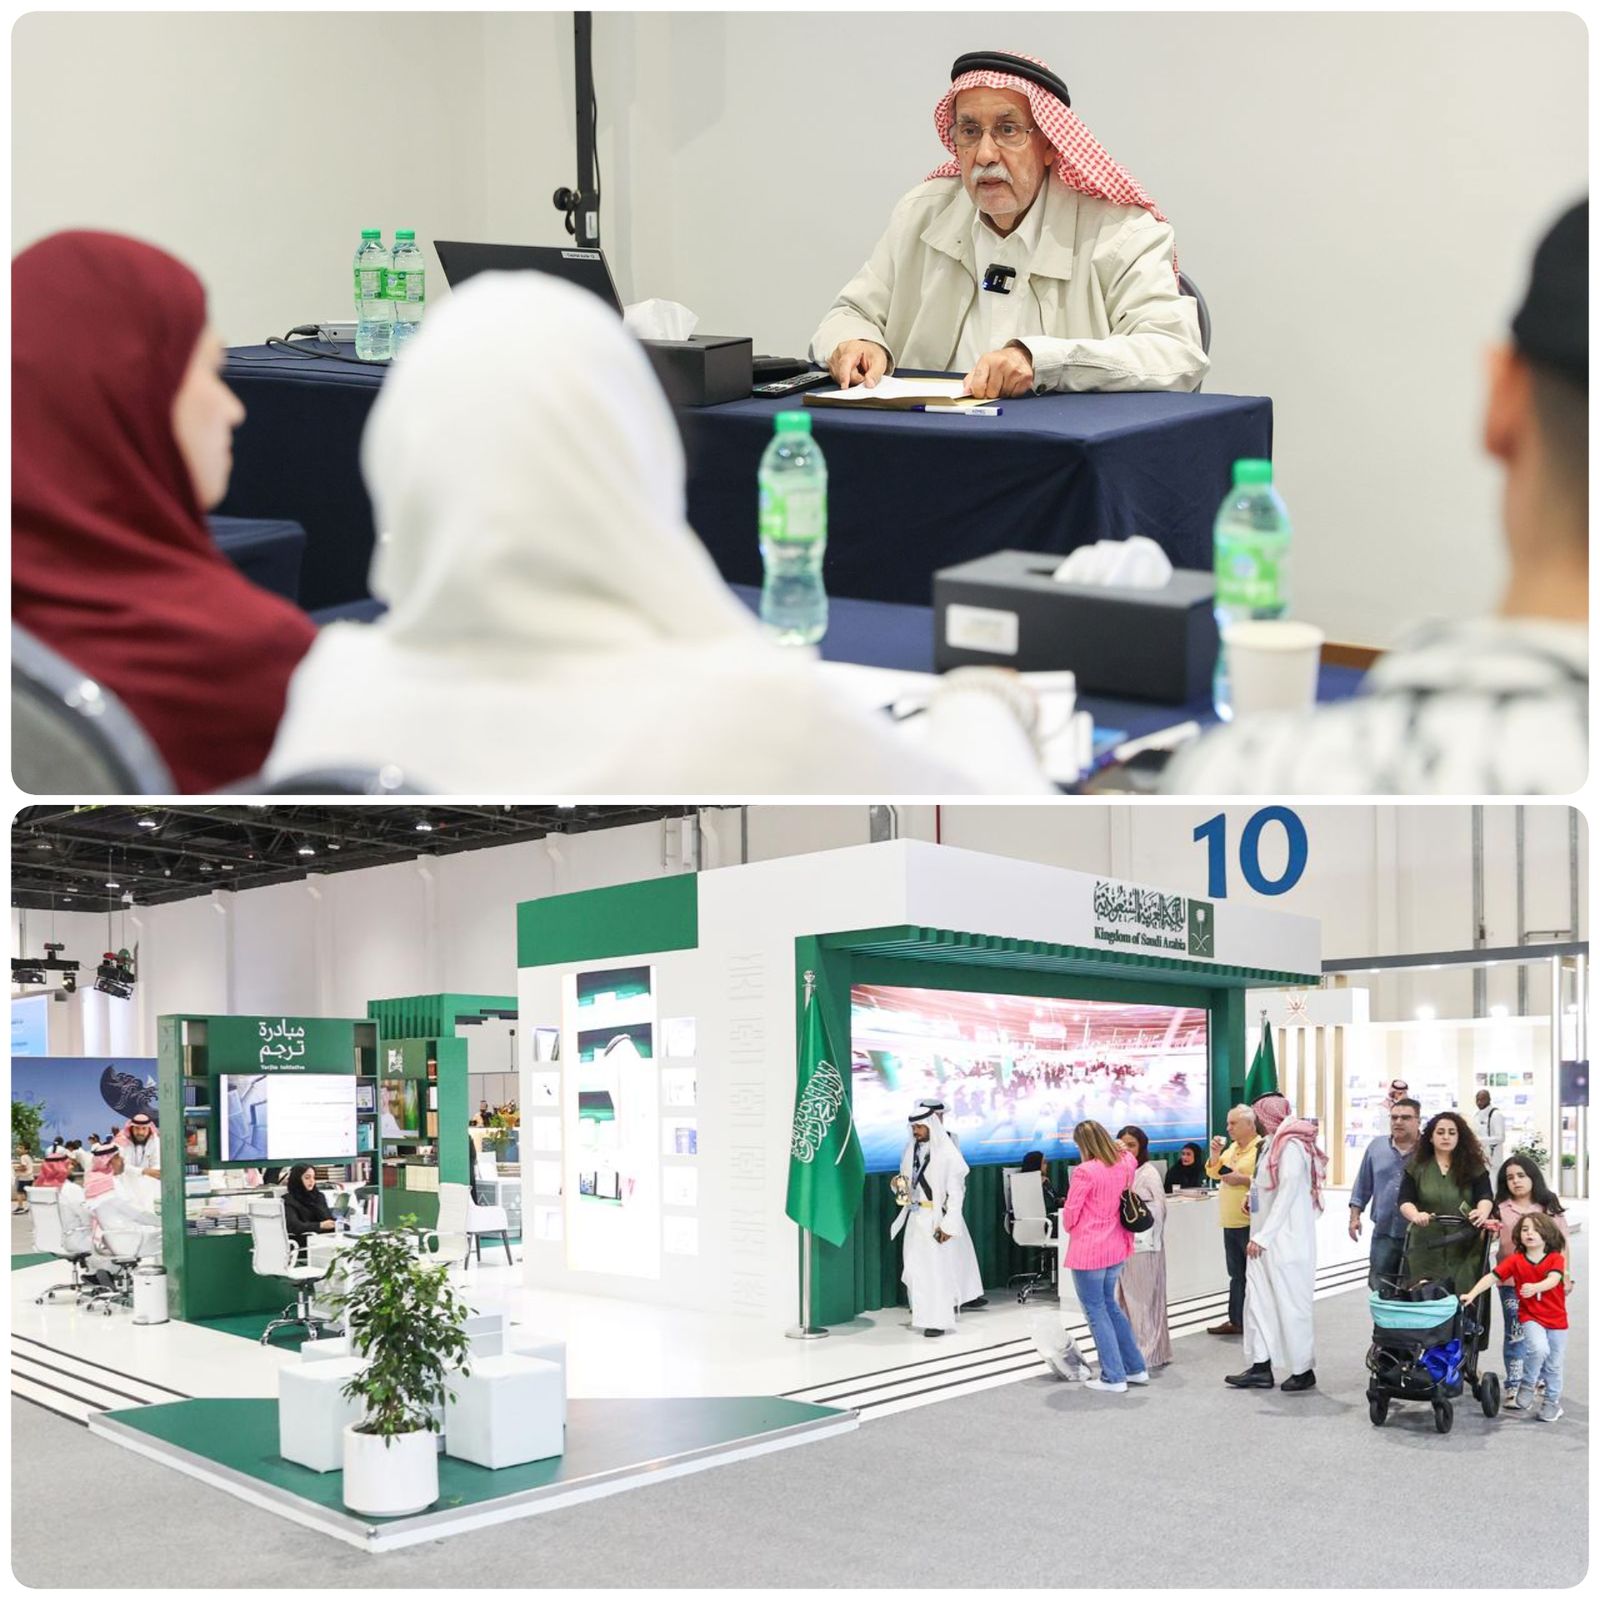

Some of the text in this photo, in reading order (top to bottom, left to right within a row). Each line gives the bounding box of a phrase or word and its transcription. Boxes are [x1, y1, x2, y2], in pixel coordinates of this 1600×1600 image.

[1193, 805, 1308, 899] 10
[1094, 926, 1186, 951] Kingdom of Saudi Arabia
[259, 1018, 305, 1042] مبادرة
[260, 1040, 305, 1063] ترجم
